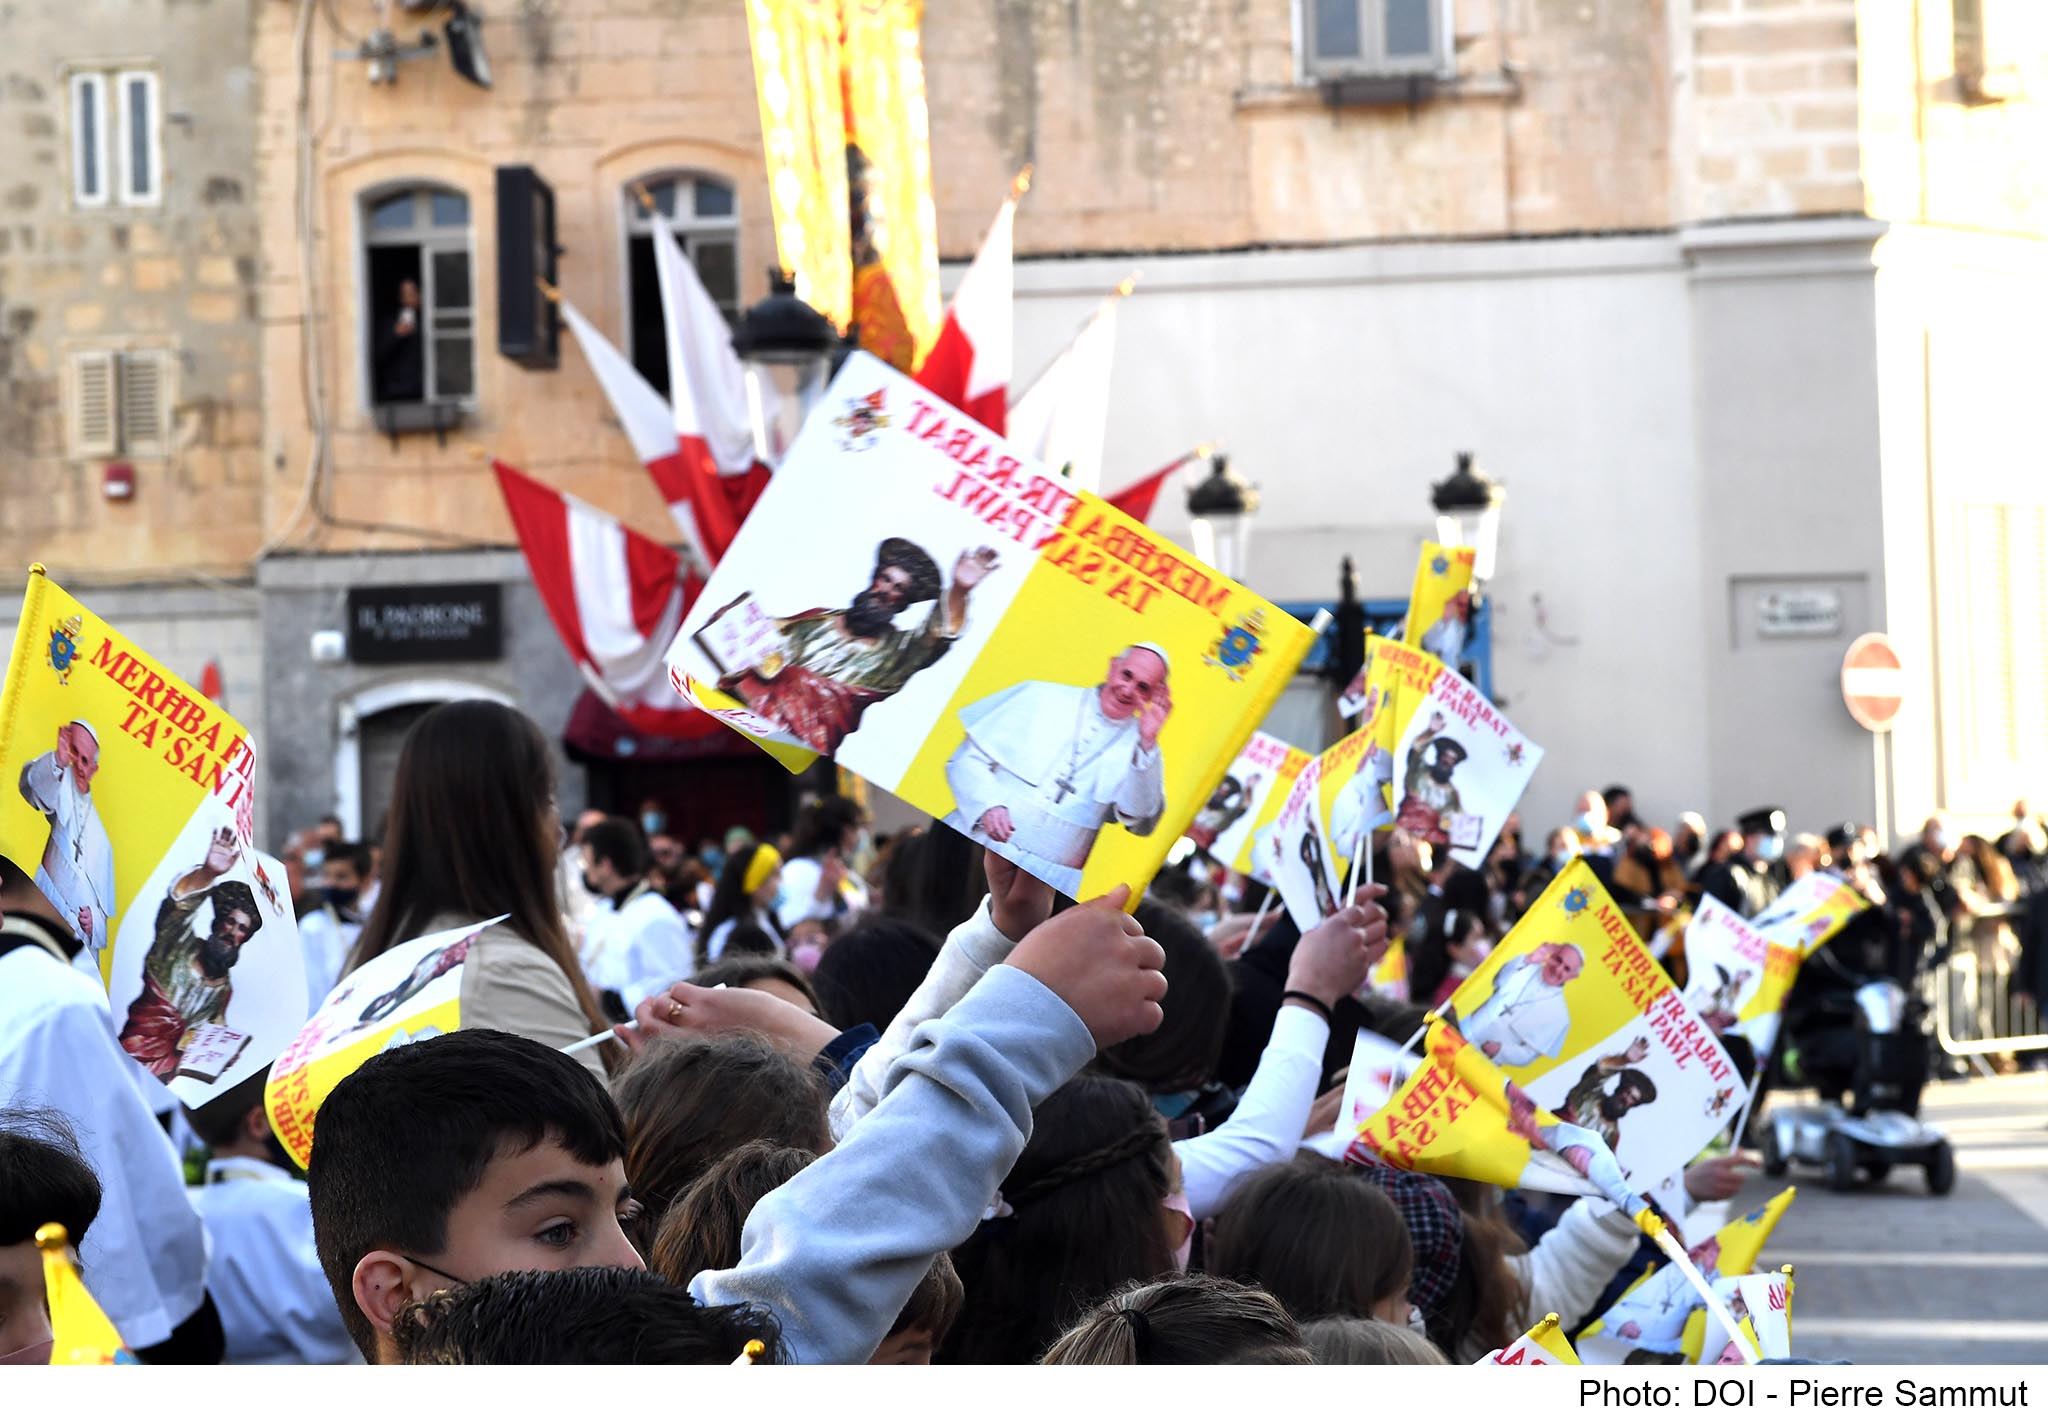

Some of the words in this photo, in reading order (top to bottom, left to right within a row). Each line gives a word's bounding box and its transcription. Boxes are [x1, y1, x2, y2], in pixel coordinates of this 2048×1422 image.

[90, 637, 222, 752] MERĦBA
[1650, 1013, 1693, 1071] PAWL
[1655, 984, 1731, 1083] FIR-RABAT
